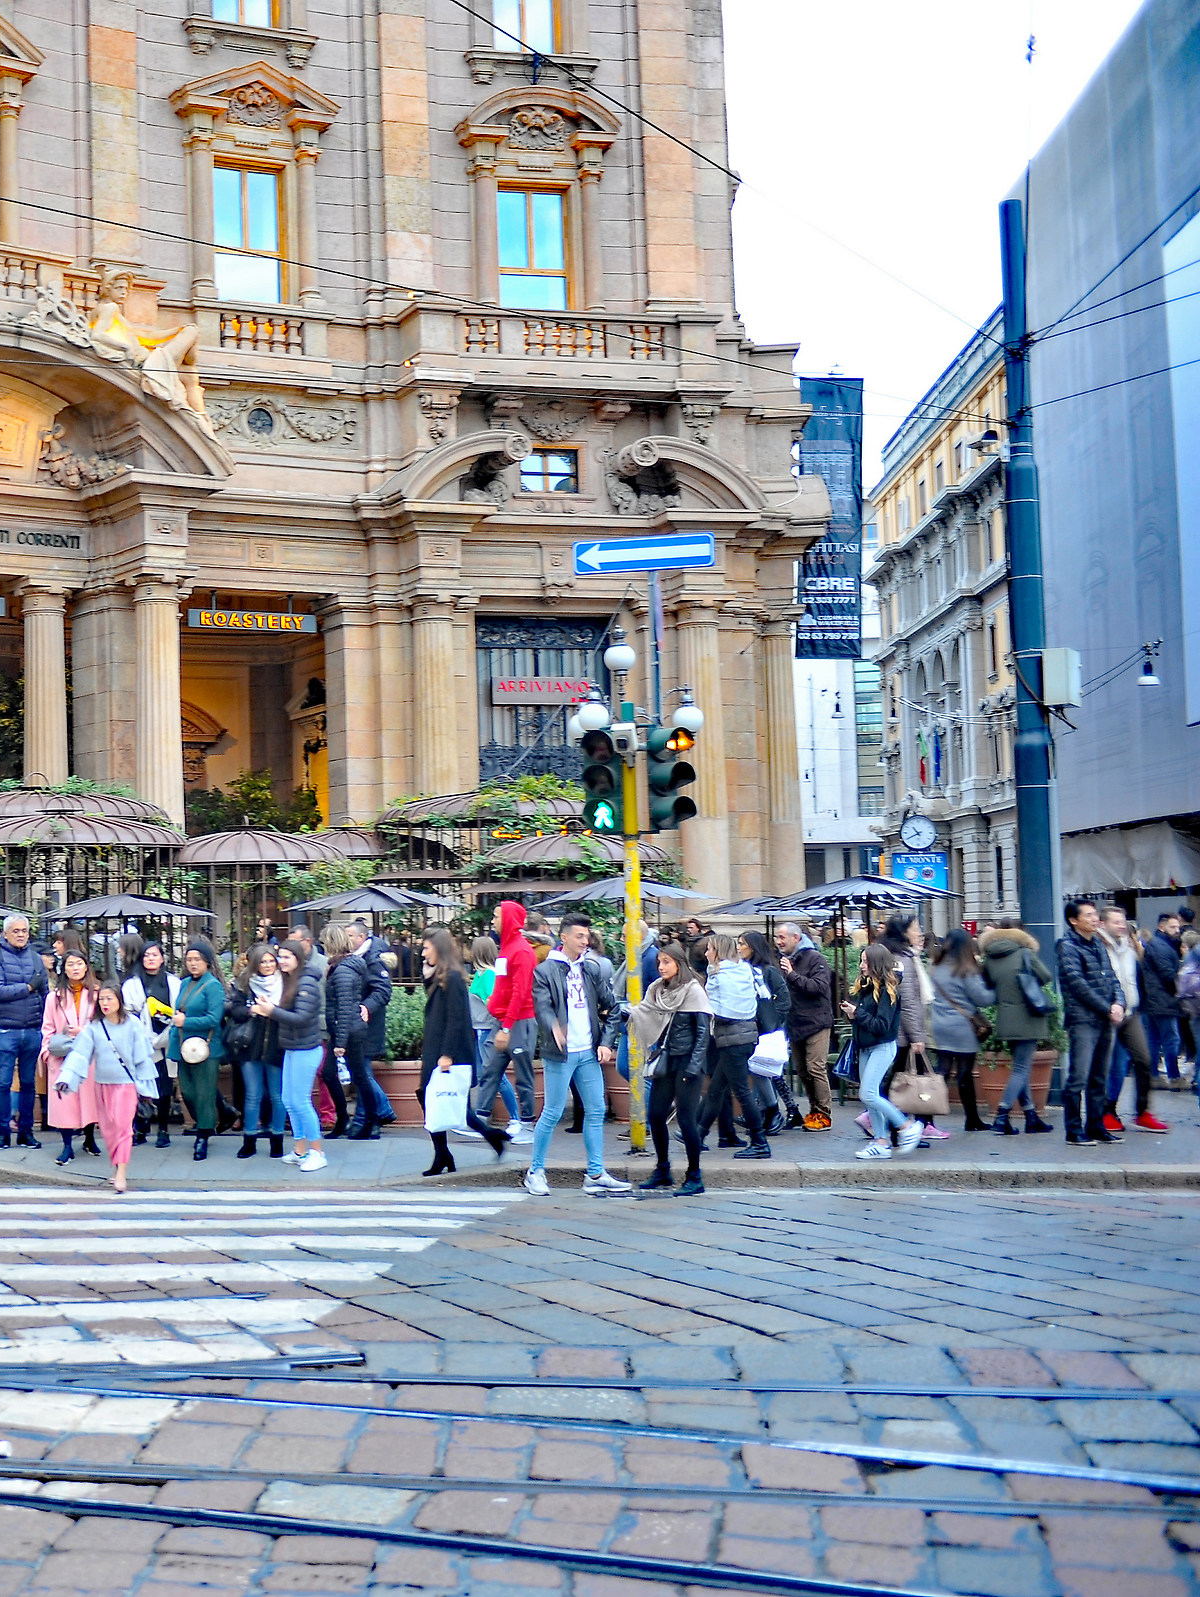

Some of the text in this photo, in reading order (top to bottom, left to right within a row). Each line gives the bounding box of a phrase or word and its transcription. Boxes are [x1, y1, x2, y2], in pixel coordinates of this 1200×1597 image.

[17, 532, 81, 550] CORRENTI
[804, 577, 855, 591] CBRE
[200, 611, 304, 630] ROASTERY
[497, 680, 591, 693] ARRIVIAMO
